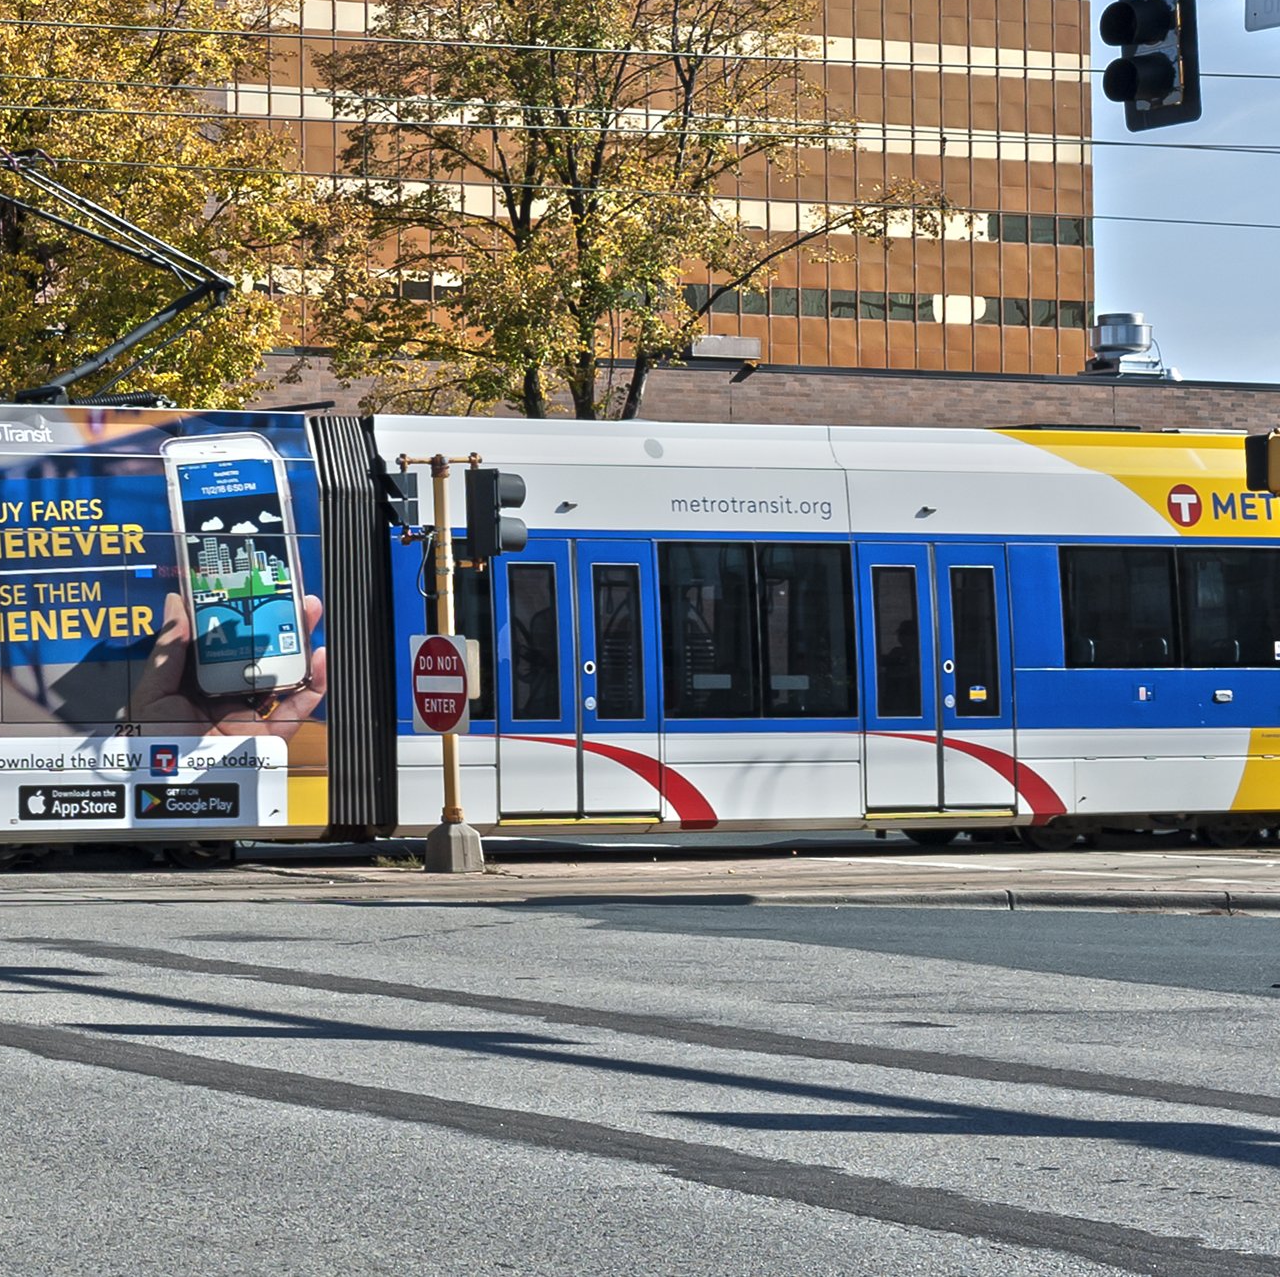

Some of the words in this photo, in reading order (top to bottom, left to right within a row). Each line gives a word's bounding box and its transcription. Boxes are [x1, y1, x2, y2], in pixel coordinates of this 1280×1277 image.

[30, 499, 104, 522] FARES
[671, 495, 832, 521] metrotransit.org
[33, 581, 102, 605] THEM
[205, 616, 228, 646] A
[419, 655, 433, 671] DO
[437, 655, 458, 671] NOT
[424, 698, 457, 714] ENTER
[114, 724, 142, 737] 221
[70, 753, 97, 768] the
[103, 753, 142, 768] NEW
[187, 756, 216, 770] app
[51, 789, 90, 798] Download
[91, 790, 101, 798] on
[103, 789, 117, 797] the
[165, 788, 180, 796] GET
[187, 788, 199, 796] ON
[51, 800, 80, 817] App
[81, 799, 118, 814] Store
[165, 798, 208, 814] Google
[208, 797, 233, 814] Play
